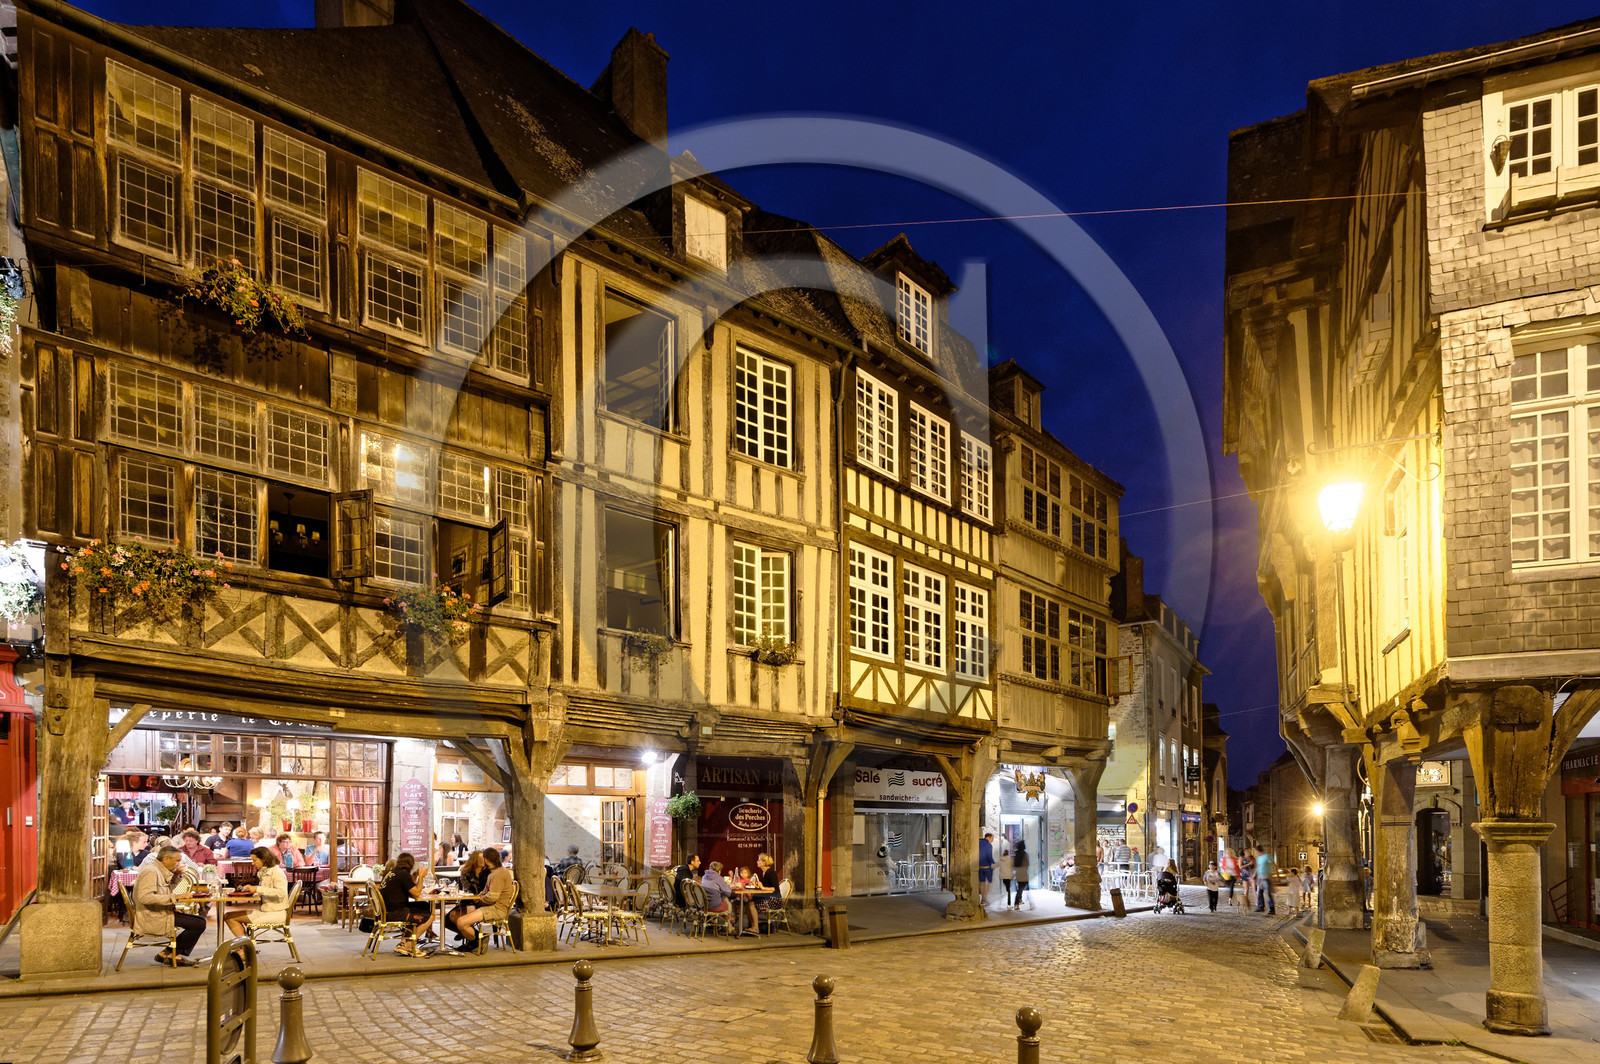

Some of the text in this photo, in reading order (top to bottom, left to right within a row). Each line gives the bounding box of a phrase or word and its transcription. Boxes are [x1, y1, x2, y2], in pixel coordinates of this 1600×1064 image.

[1562, 755, 1599, 770] PHARMACIE
[702, 765, 760, 785] ARTISAN
[912, 774, 943, 787] sucré
[879, 794, 920, 802] sandwicherie
